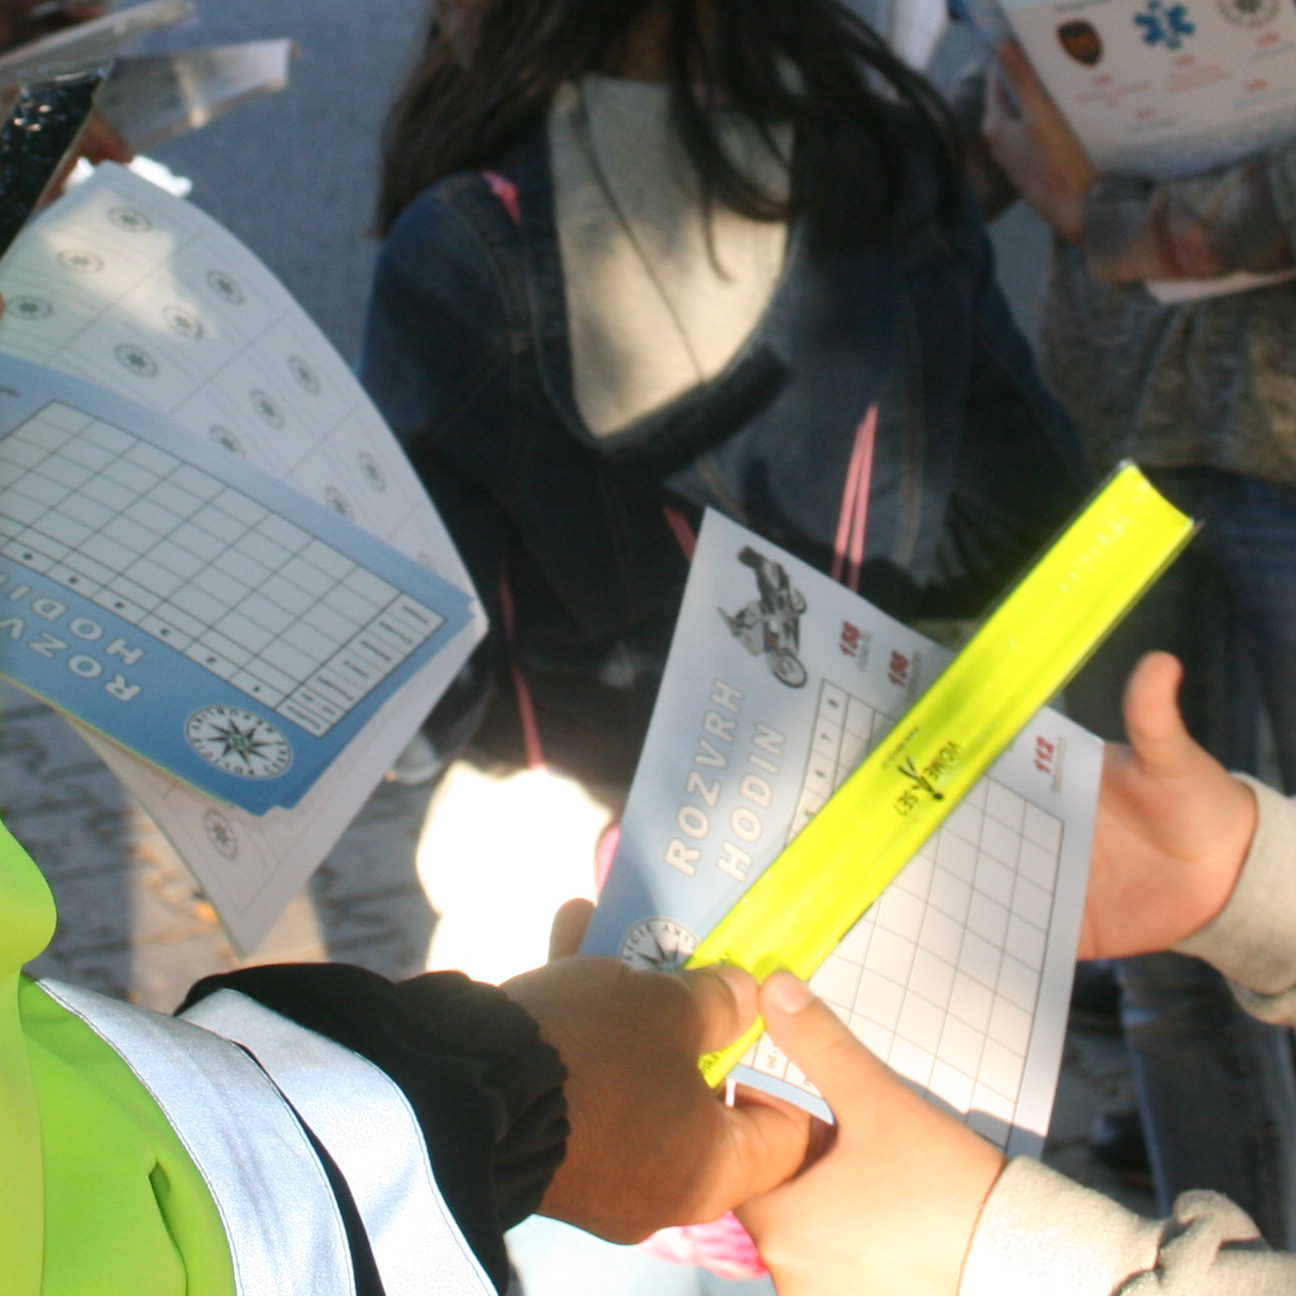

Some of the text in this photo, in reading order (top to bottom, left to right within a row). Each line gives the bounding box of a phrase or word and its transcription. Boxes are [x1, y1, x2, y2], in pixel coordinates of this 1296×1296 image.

[664, 677, 744, 878] ROZVRH
[716, 721, 786, 883] HODIN
[1033, 735, 1055, 774] 112
